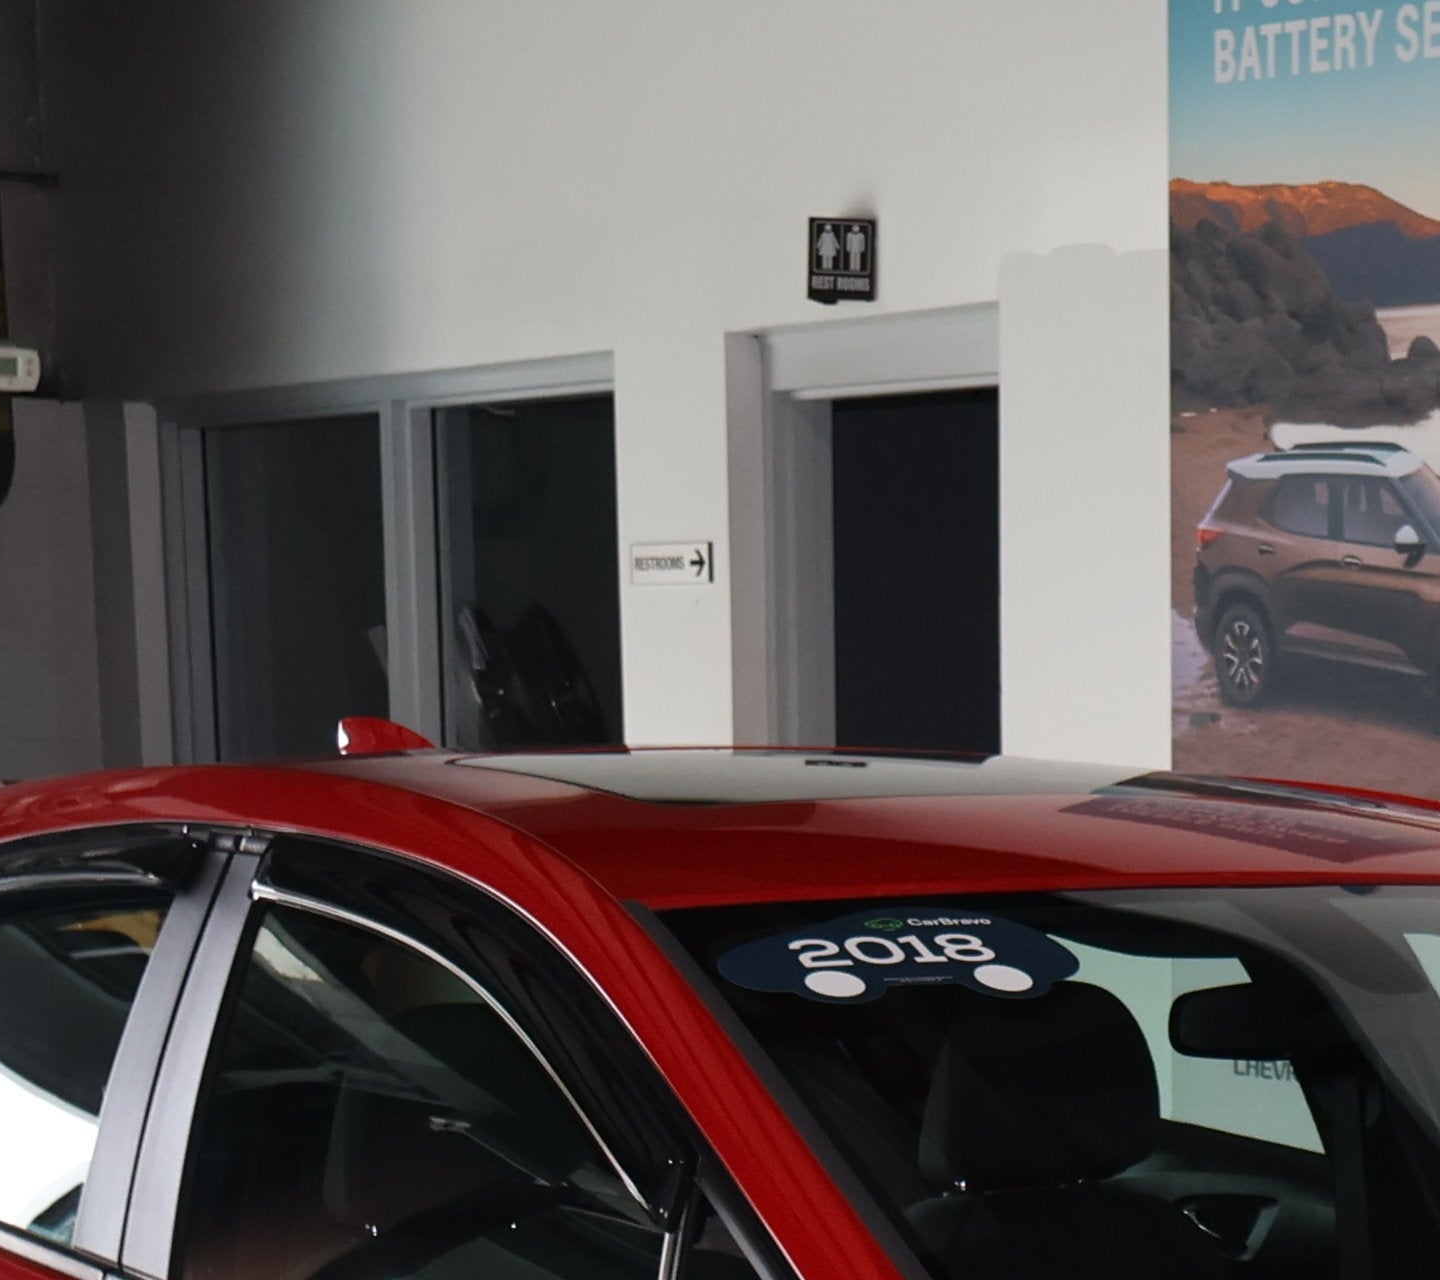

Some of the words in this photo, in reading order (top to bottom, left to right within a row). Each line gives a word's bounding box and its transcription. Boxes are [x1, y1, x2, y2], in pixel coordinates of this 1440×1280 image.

[1214, 9, 1383, 83] BATTERY
[811, 275, 835, 290] REST
[835, 276, 871, 292] ROOMS
[634, 556, 685, 572] RESTROOMS
[906, 917, 992, 927] CarBravo
[788, 933, 996, 969] 2018
